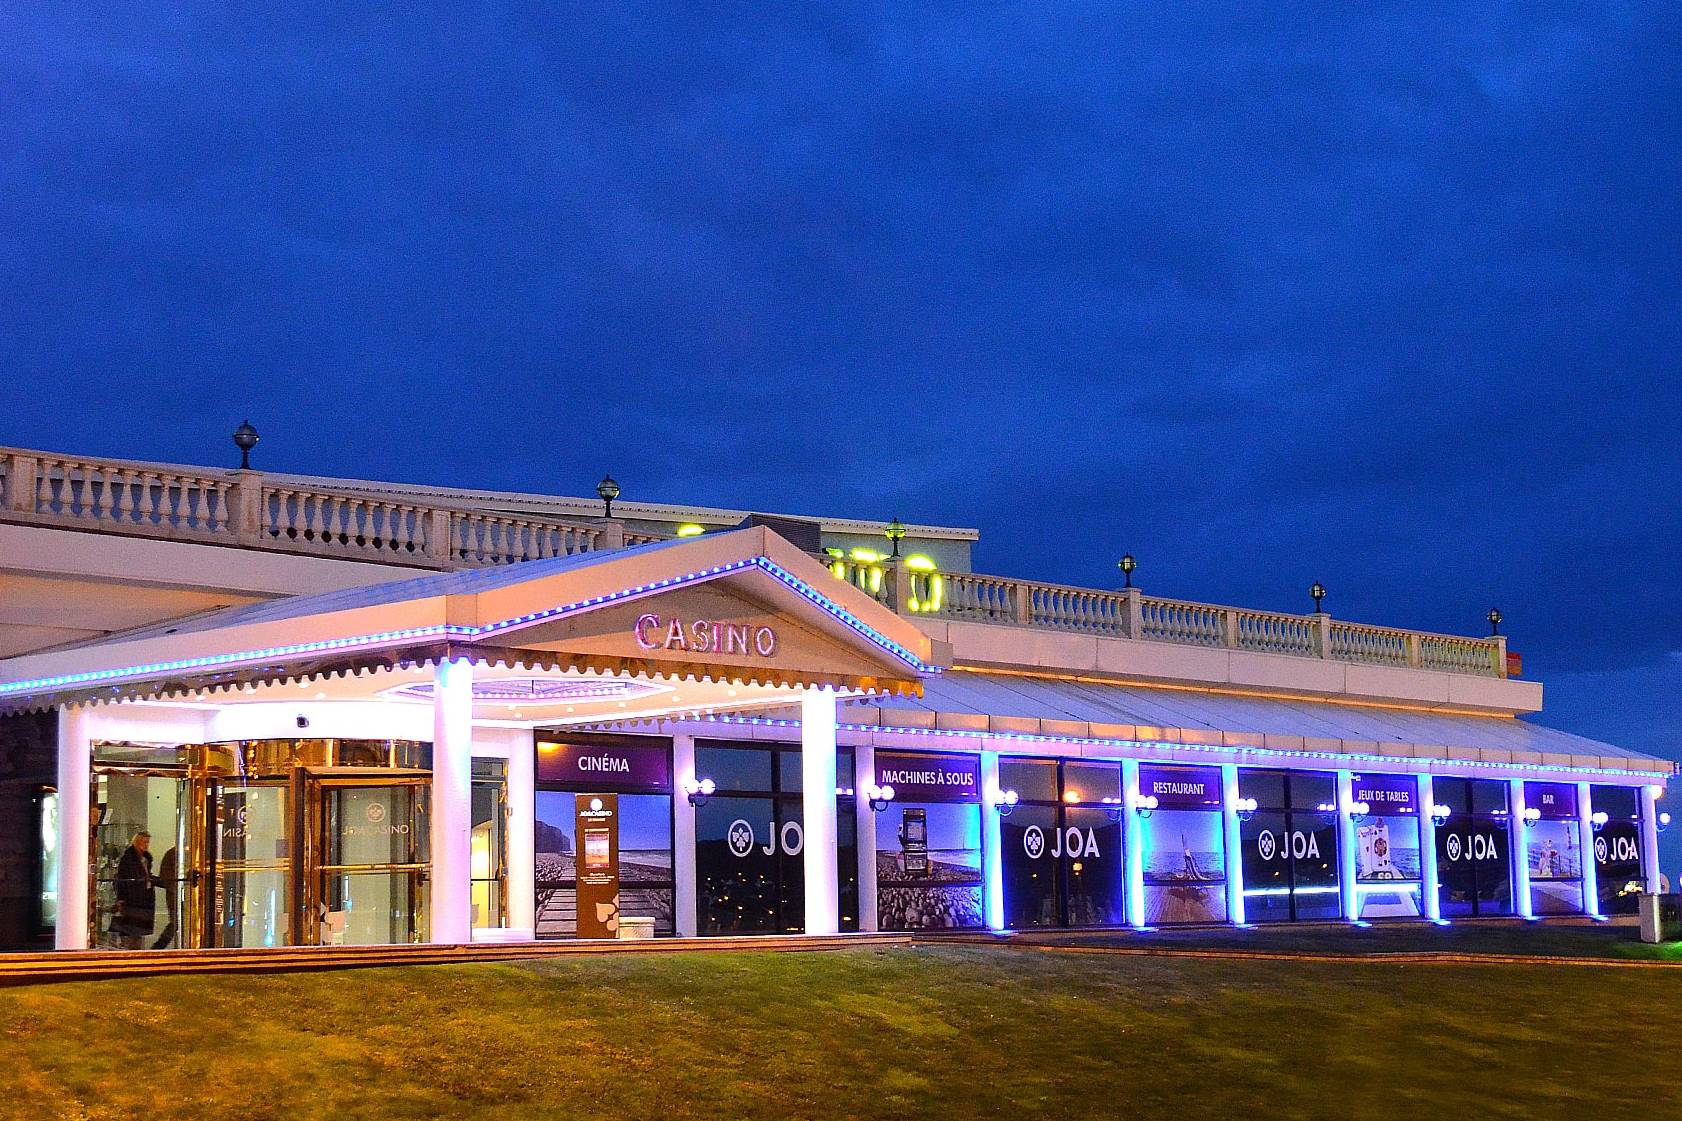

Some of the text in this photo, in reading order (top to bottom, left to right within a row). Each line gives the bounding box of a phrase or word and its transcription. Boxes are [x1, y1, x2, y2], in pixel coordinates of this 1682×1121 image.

[634, 612, 777, 657] CASINO
[577, 753, 630, 773] CINÉMA
[881, 768, 974, 786] MACHINES À SOUS
[1153, 781, 1205, 795] RESTAURANT
[1358, 789, 1409, 802] JEUX DE TABLES
[1542, 794, 1555, 804] BAR
[762, 821, 804, 856] JO
[1050, 826, 1101, 858] JOA
[1280, 830, 1320, 859] JOA
[1464, 833, 1498, 860] JOA
[1610, 836, 1639, 861] JOA
